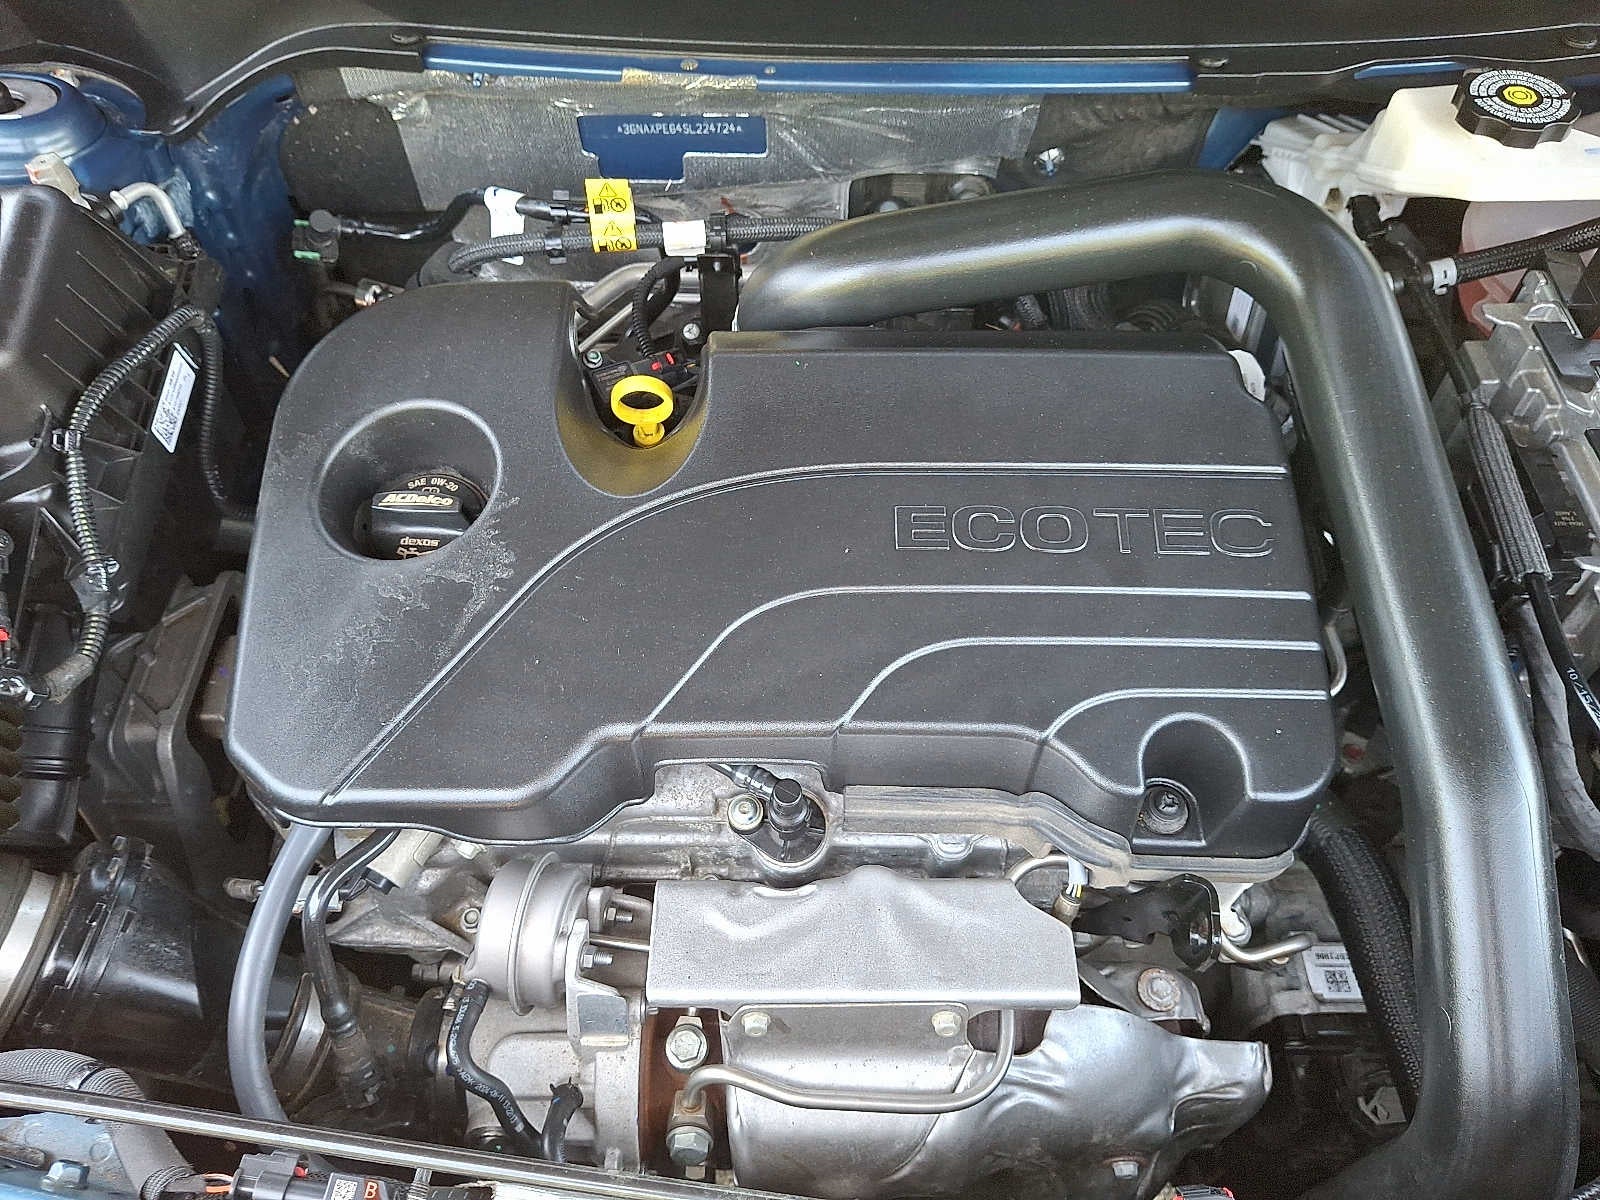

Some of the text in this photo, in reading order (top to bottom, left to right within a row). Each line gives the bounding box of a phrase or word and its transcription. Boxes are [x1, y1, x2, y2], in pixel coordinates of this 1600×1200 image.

[407, 478, 459, 492] SAE 0W-20
[380, 493, 454, 506] ACDelco
[893, 504, 1276, 558] ECOTEC
[400, 536, 440, 546] dexos
[364, 1181, 378, 1198] B
